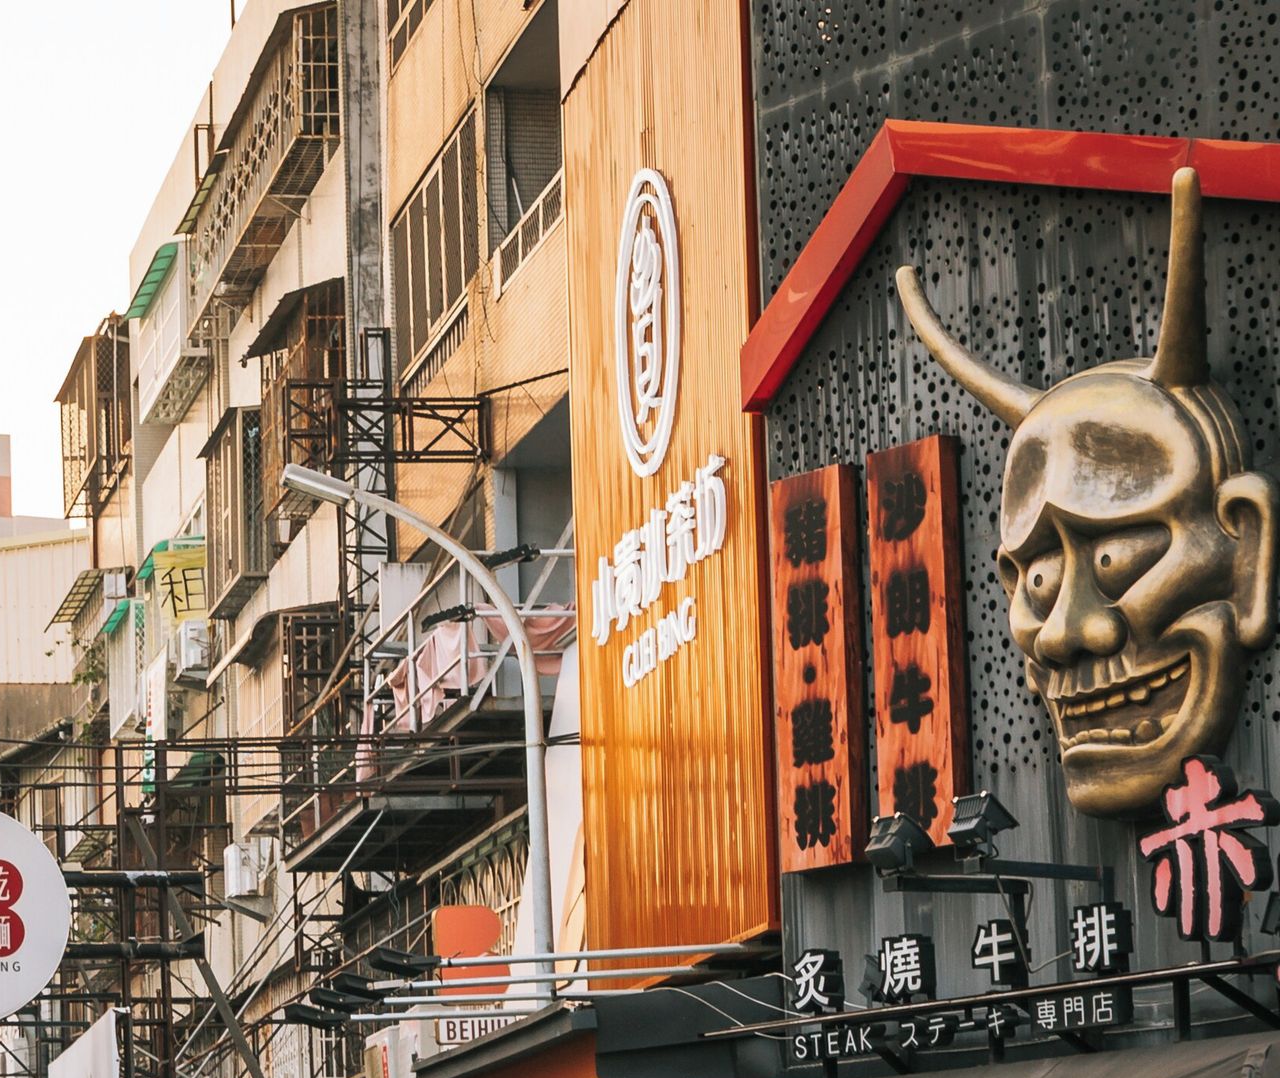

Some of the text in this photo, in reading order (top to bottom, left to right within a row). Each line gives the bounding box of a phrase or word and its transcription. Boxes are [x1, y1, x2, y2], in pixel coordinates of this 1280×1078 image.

[160, 567, 206, 618] 租
[622, 596, 697, 689] GUEI BING
[1140, 759, 1265, 937] 赤
[793, 904, 1119, 1010] 炙燒牛排
[795, 1008, 1006, 1060] STEAK ステーキ
